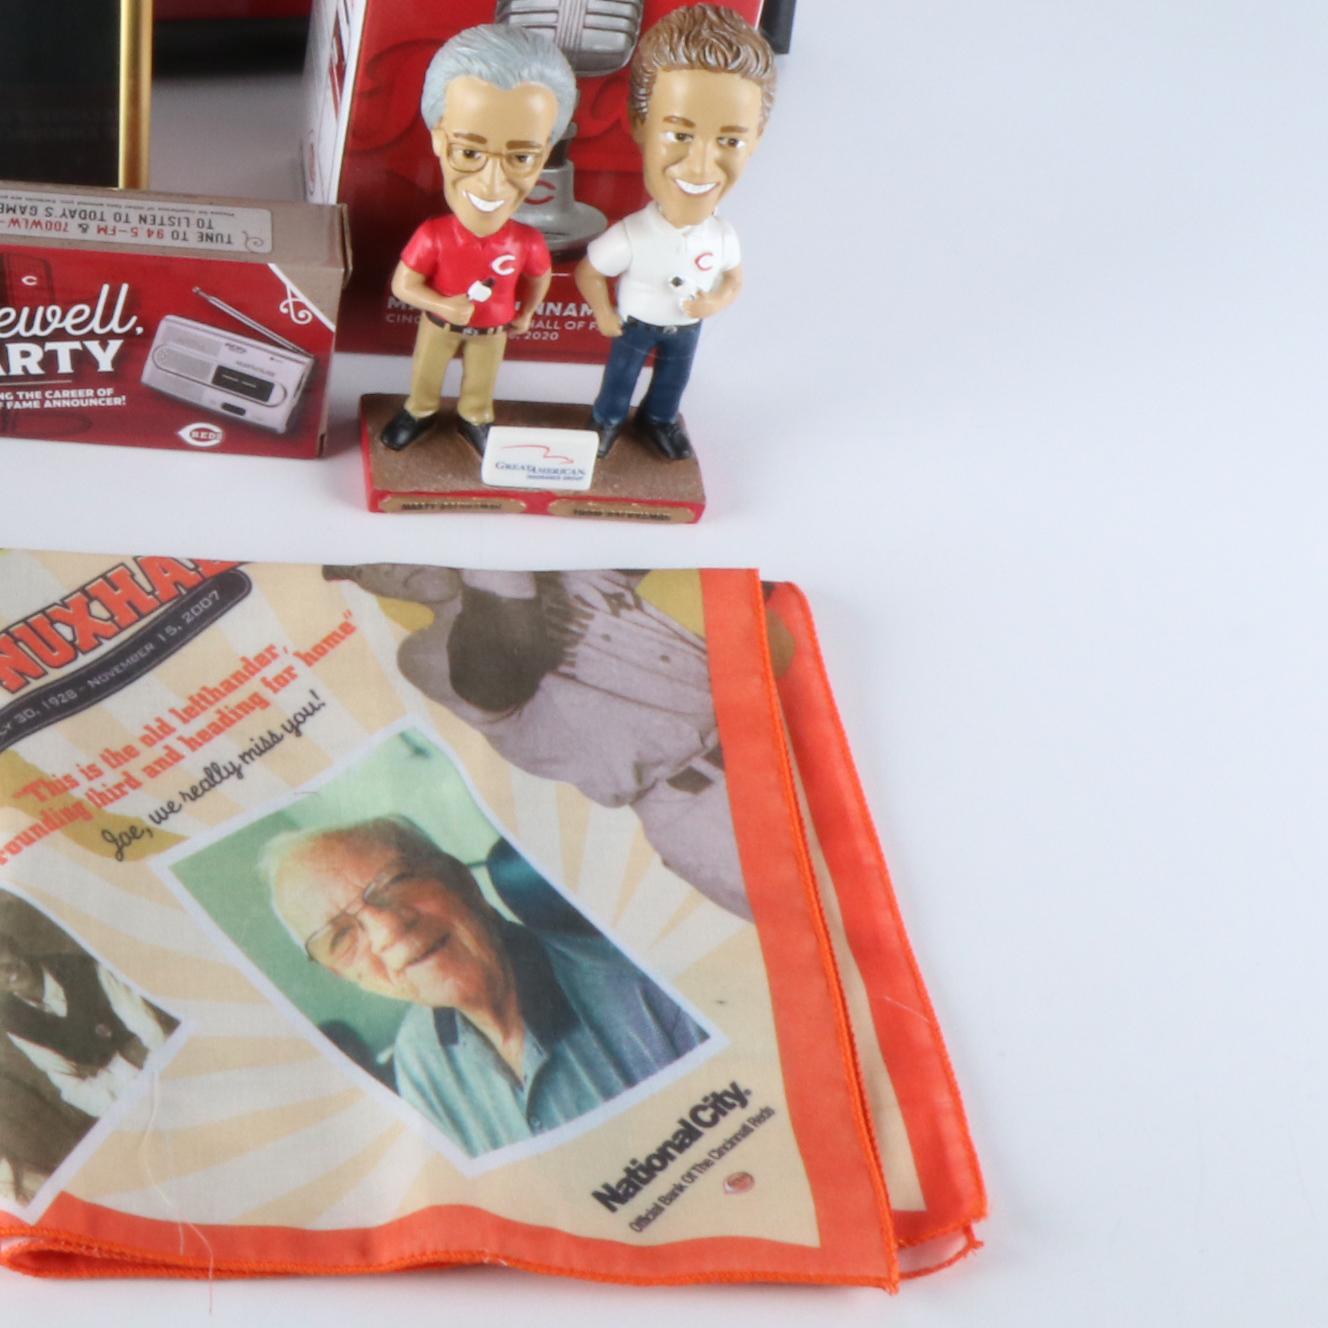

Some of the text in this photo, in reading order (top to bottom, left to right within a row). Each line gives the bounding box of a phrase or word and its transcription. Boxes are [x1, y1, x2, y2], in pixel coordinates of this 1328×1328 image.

[46, 206, 105, 223] TODAY'S
[113, 211, 131, 225] TO
[138, 213, 191, 229] LISTEN
[77, 222, 88, 234] &
[194, 218, 213, 231] TO
[171, 229, 189, 243] TO
[197, 230, 233, 245] TUNE
[524, 331, 559, 342] 2020
[16, 390, 42, 401] THE
[45, 389, 94, 400] CAREER
[97, 387, 114, 398] OF
[6, 399, 40, 410] FAME
[44, 395, 127, 409] ANNOUNCER!
[14, 707, 40, 724] 30,
[41, 689, 79, 711] 1928
[86, 641, 156, 688] NOVEMBER
[182, 589, 222, 624] 2007
[76, 763, 104, 782] is
[99, 743, 141, 770] the
[139, 716, 177, 748] old
[168, 643, 289, 724] lefthander,
[85, 770, 144, 809] third
[142, 744, 185, 779] and
[176, 691, 271, 752] heading
[260, 665, 299, 695] for
[101, 688, 327, 863] Joe, we really miss you!
[591, 1117, 704, 1214] National
[628, 1197, 666, 1234] Official
[657, 1180, 688, 1206] Bank
[681, 1166, 699, 1185] Of
[691, 1156, 715, 1178] The
[707, 1123, 755, 1161] Cincinnati
[747, 1105, 776, 1130] Reds
